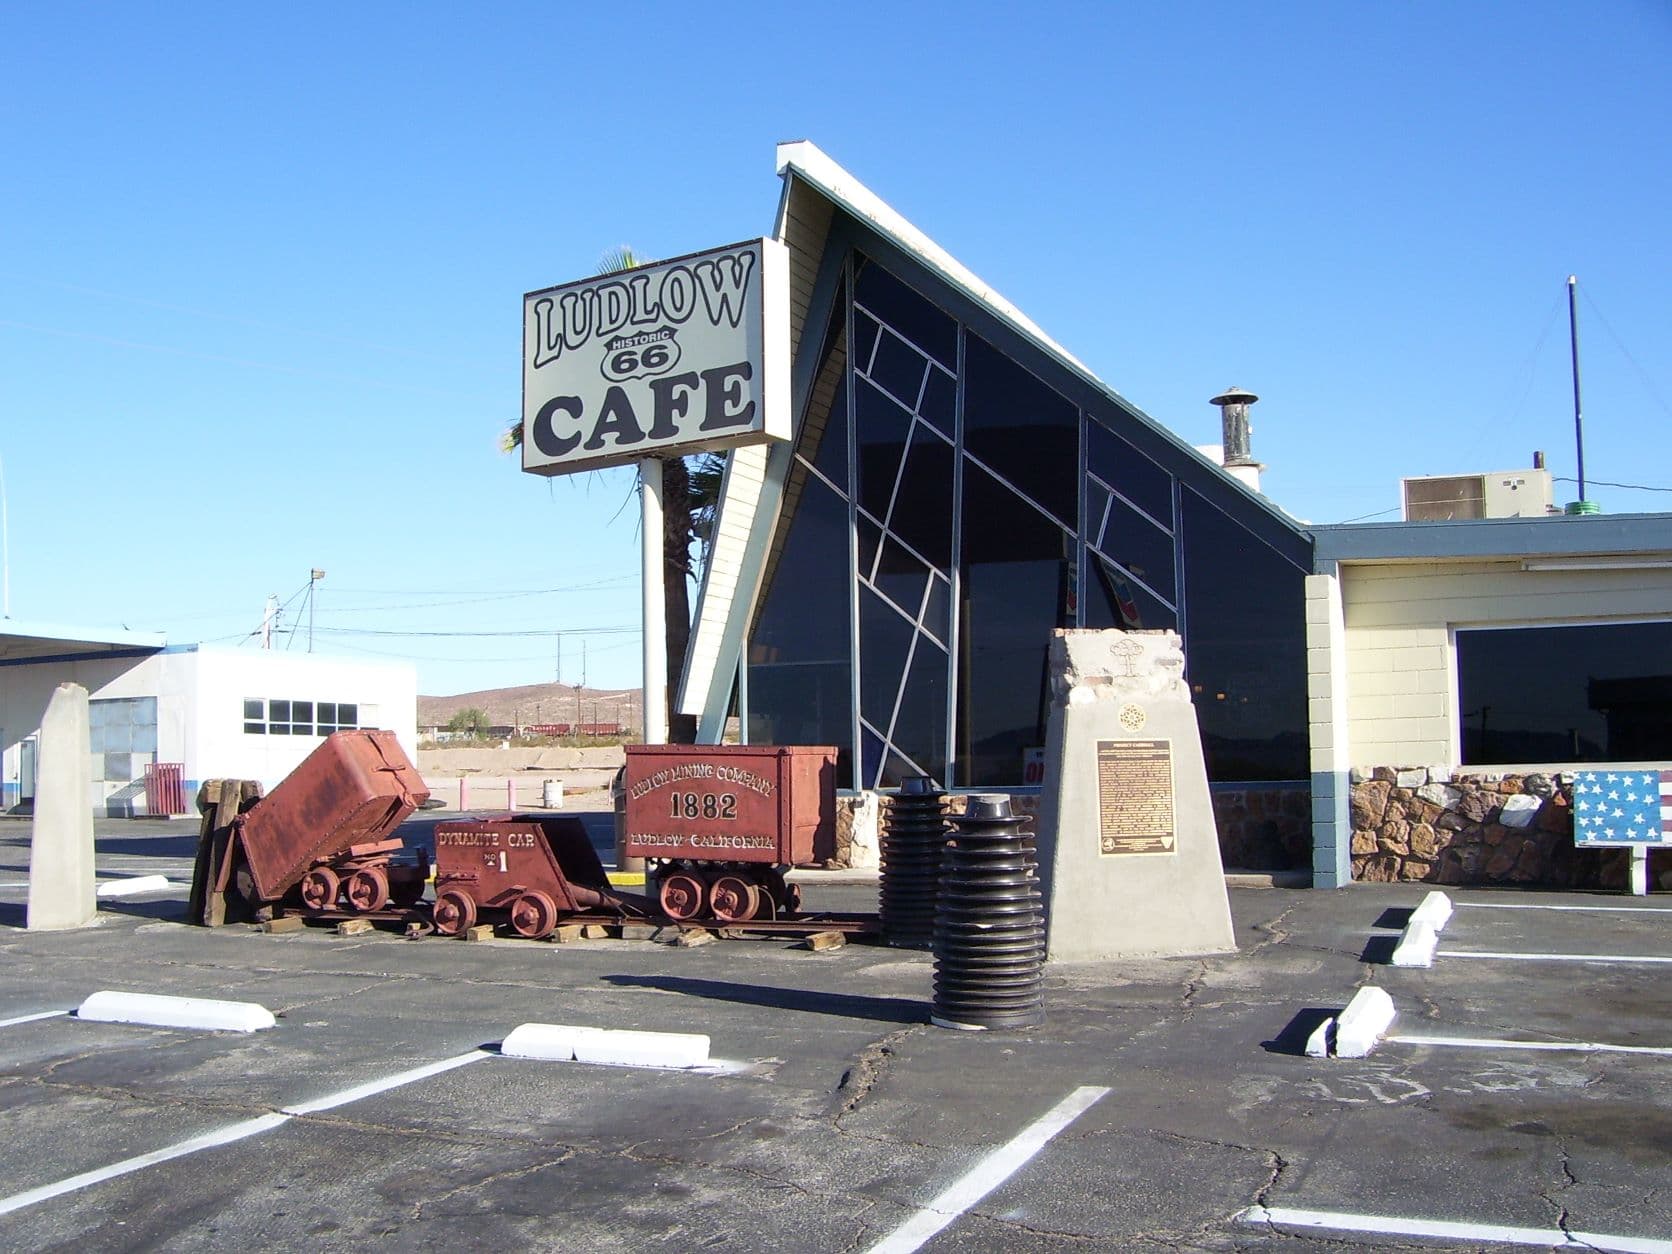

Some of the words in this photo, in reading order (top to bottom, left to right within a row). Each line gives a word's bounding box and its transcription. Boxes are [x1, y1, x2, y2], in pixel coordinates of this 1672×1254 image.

[534, 250, 755, 369] LUDLOW
[612, 330, 670, 350] HISTORIC
[611, 344, 669, 375] 66
[533, 361, 756, 457] CAFE
[630, 768, 670, 799] LUDLOW
[671, 763, 714, 782] MINING
[716, 765, 776, 797] COMPANY
[670, 791, 738, 820] 1882
[438, 832, 500, 846] DYNAMITE
[508, 833, 535, 847] CAR
[631, 833, 684, 847] LUDLOW
[689, 833, 776, 849] CALIFORNIA
